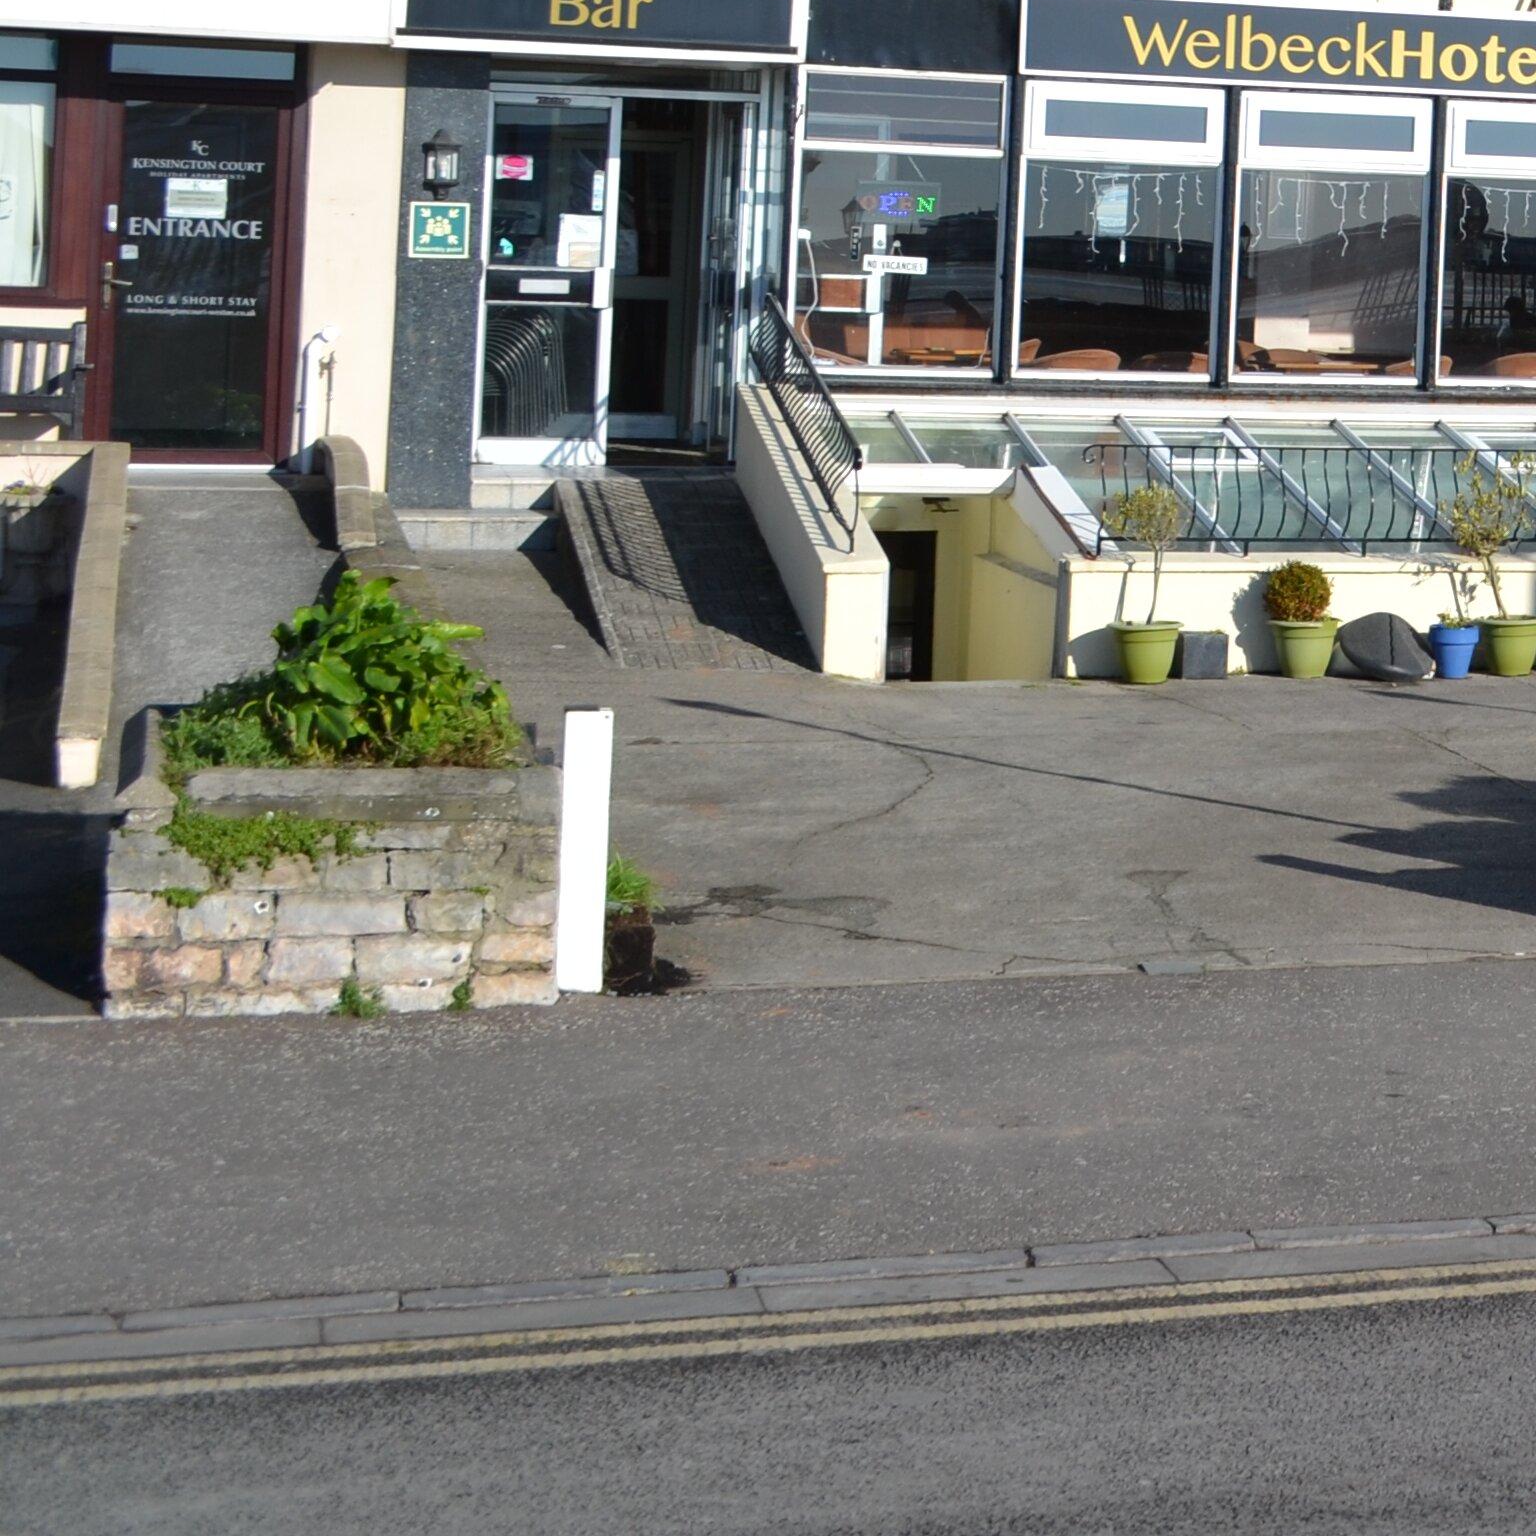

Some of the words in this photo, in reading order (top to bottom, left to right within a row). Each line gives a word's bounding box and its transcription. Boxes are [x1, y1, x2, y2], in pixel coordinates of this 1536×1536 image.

[132, 157, 217, 170] KENSINGTON
[218, 161, 266, 173] COURT
[859, 195, 935, 212] OPEN
[127, 216, 264, 240] ENTRANCE
[867, 260, 878, 269] NO
[881, 261, 924, 272] VACANCIES
[126, 294, 165, 305] LONG
[168, 295, 178, 305] &
[181, 296, 225, 306] SHORT
[227, 297, 258, 307] STAY
